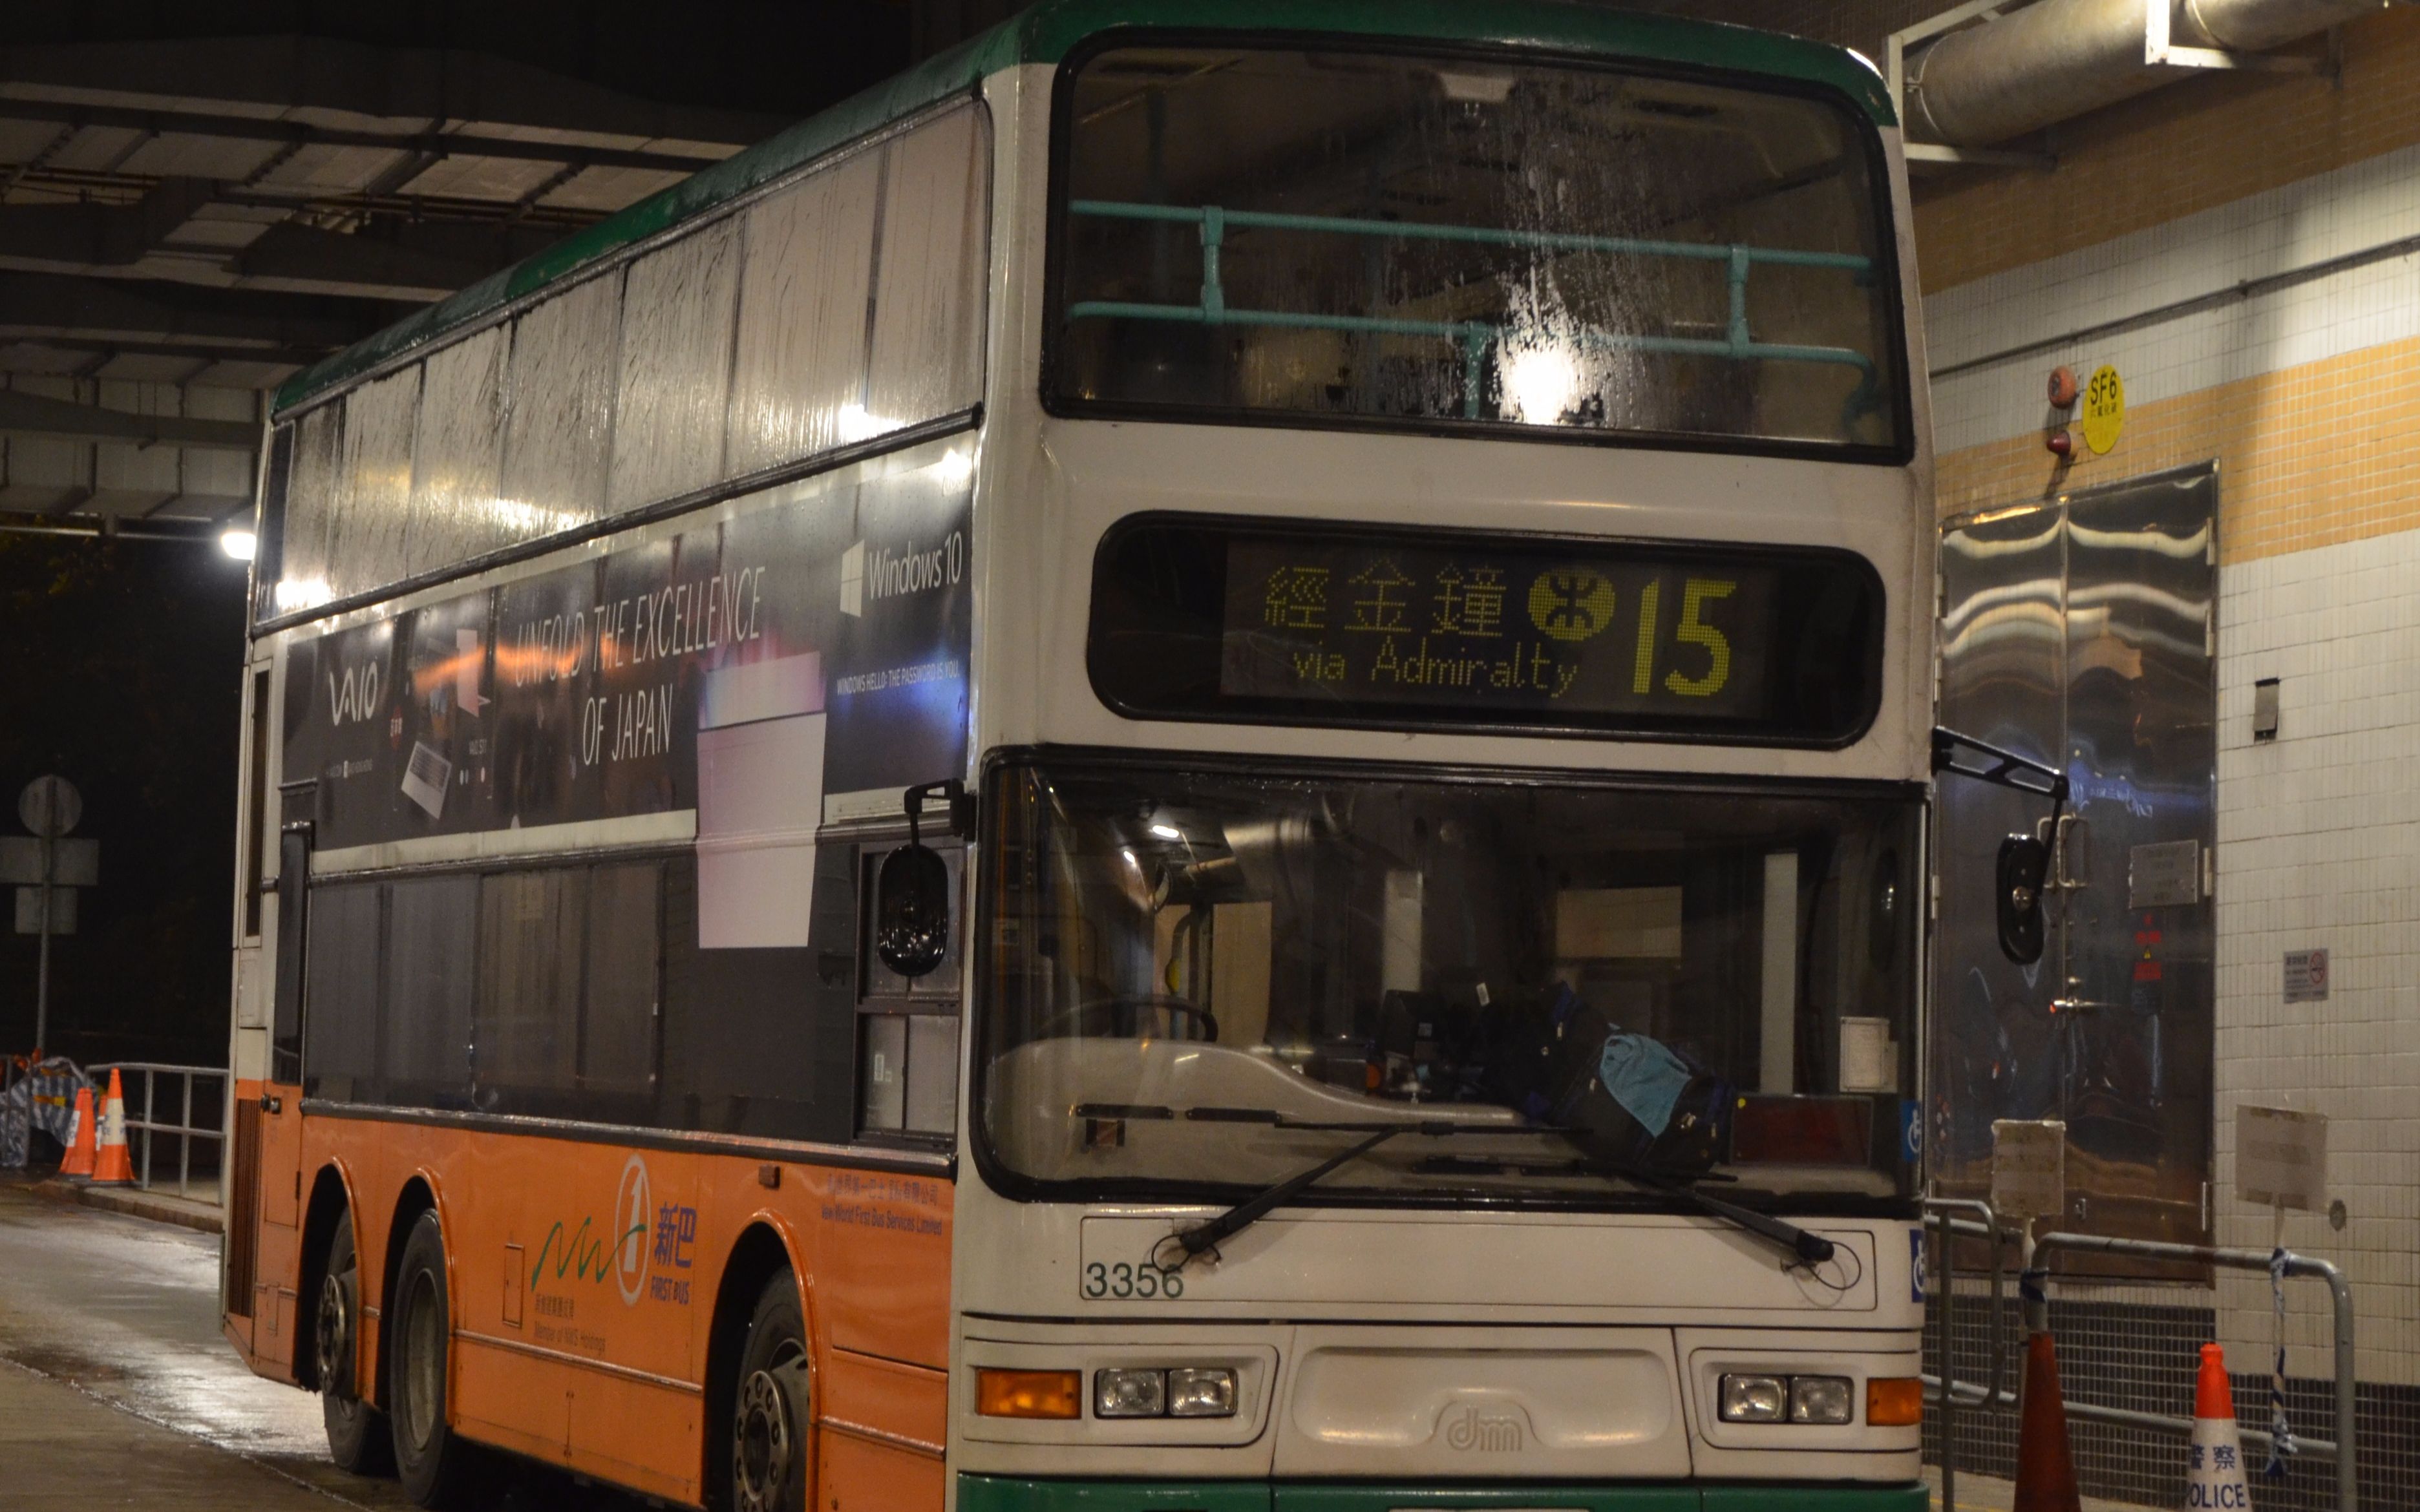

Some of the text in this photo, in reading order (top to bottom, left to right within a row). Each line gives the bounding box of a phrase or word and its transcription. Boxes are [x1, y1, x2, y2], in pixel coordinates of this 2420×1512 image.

[2090, 370, 2117, 406] SF6
[869, 530, 962, 600] Windows 10
[516, 566, 765, 688] UNFOLD THE EXCELLENCE
[1633, 578, 1737, 696] 15
[329, 661, 377, 726] VAIO
[836, 675, 865, 696] WINDOWS
[867, 671, 887, 690] HELLO:
[888, 669, 900, 688] THE
[902, 662, 935, 686] PASSWORD
[936, 661, 944, 680] IS
[1293, 635, 1578, 698] via Admiralty
[583, 683, 673, 766] OF JAPAN
[655, 1201, 697, 1268] 新巴
[650, 1275, 673, 1303] FIRST
[1085, 1262, 1184, 1298] 3356
[2188, 1483, 2246, 1509] OLICE
